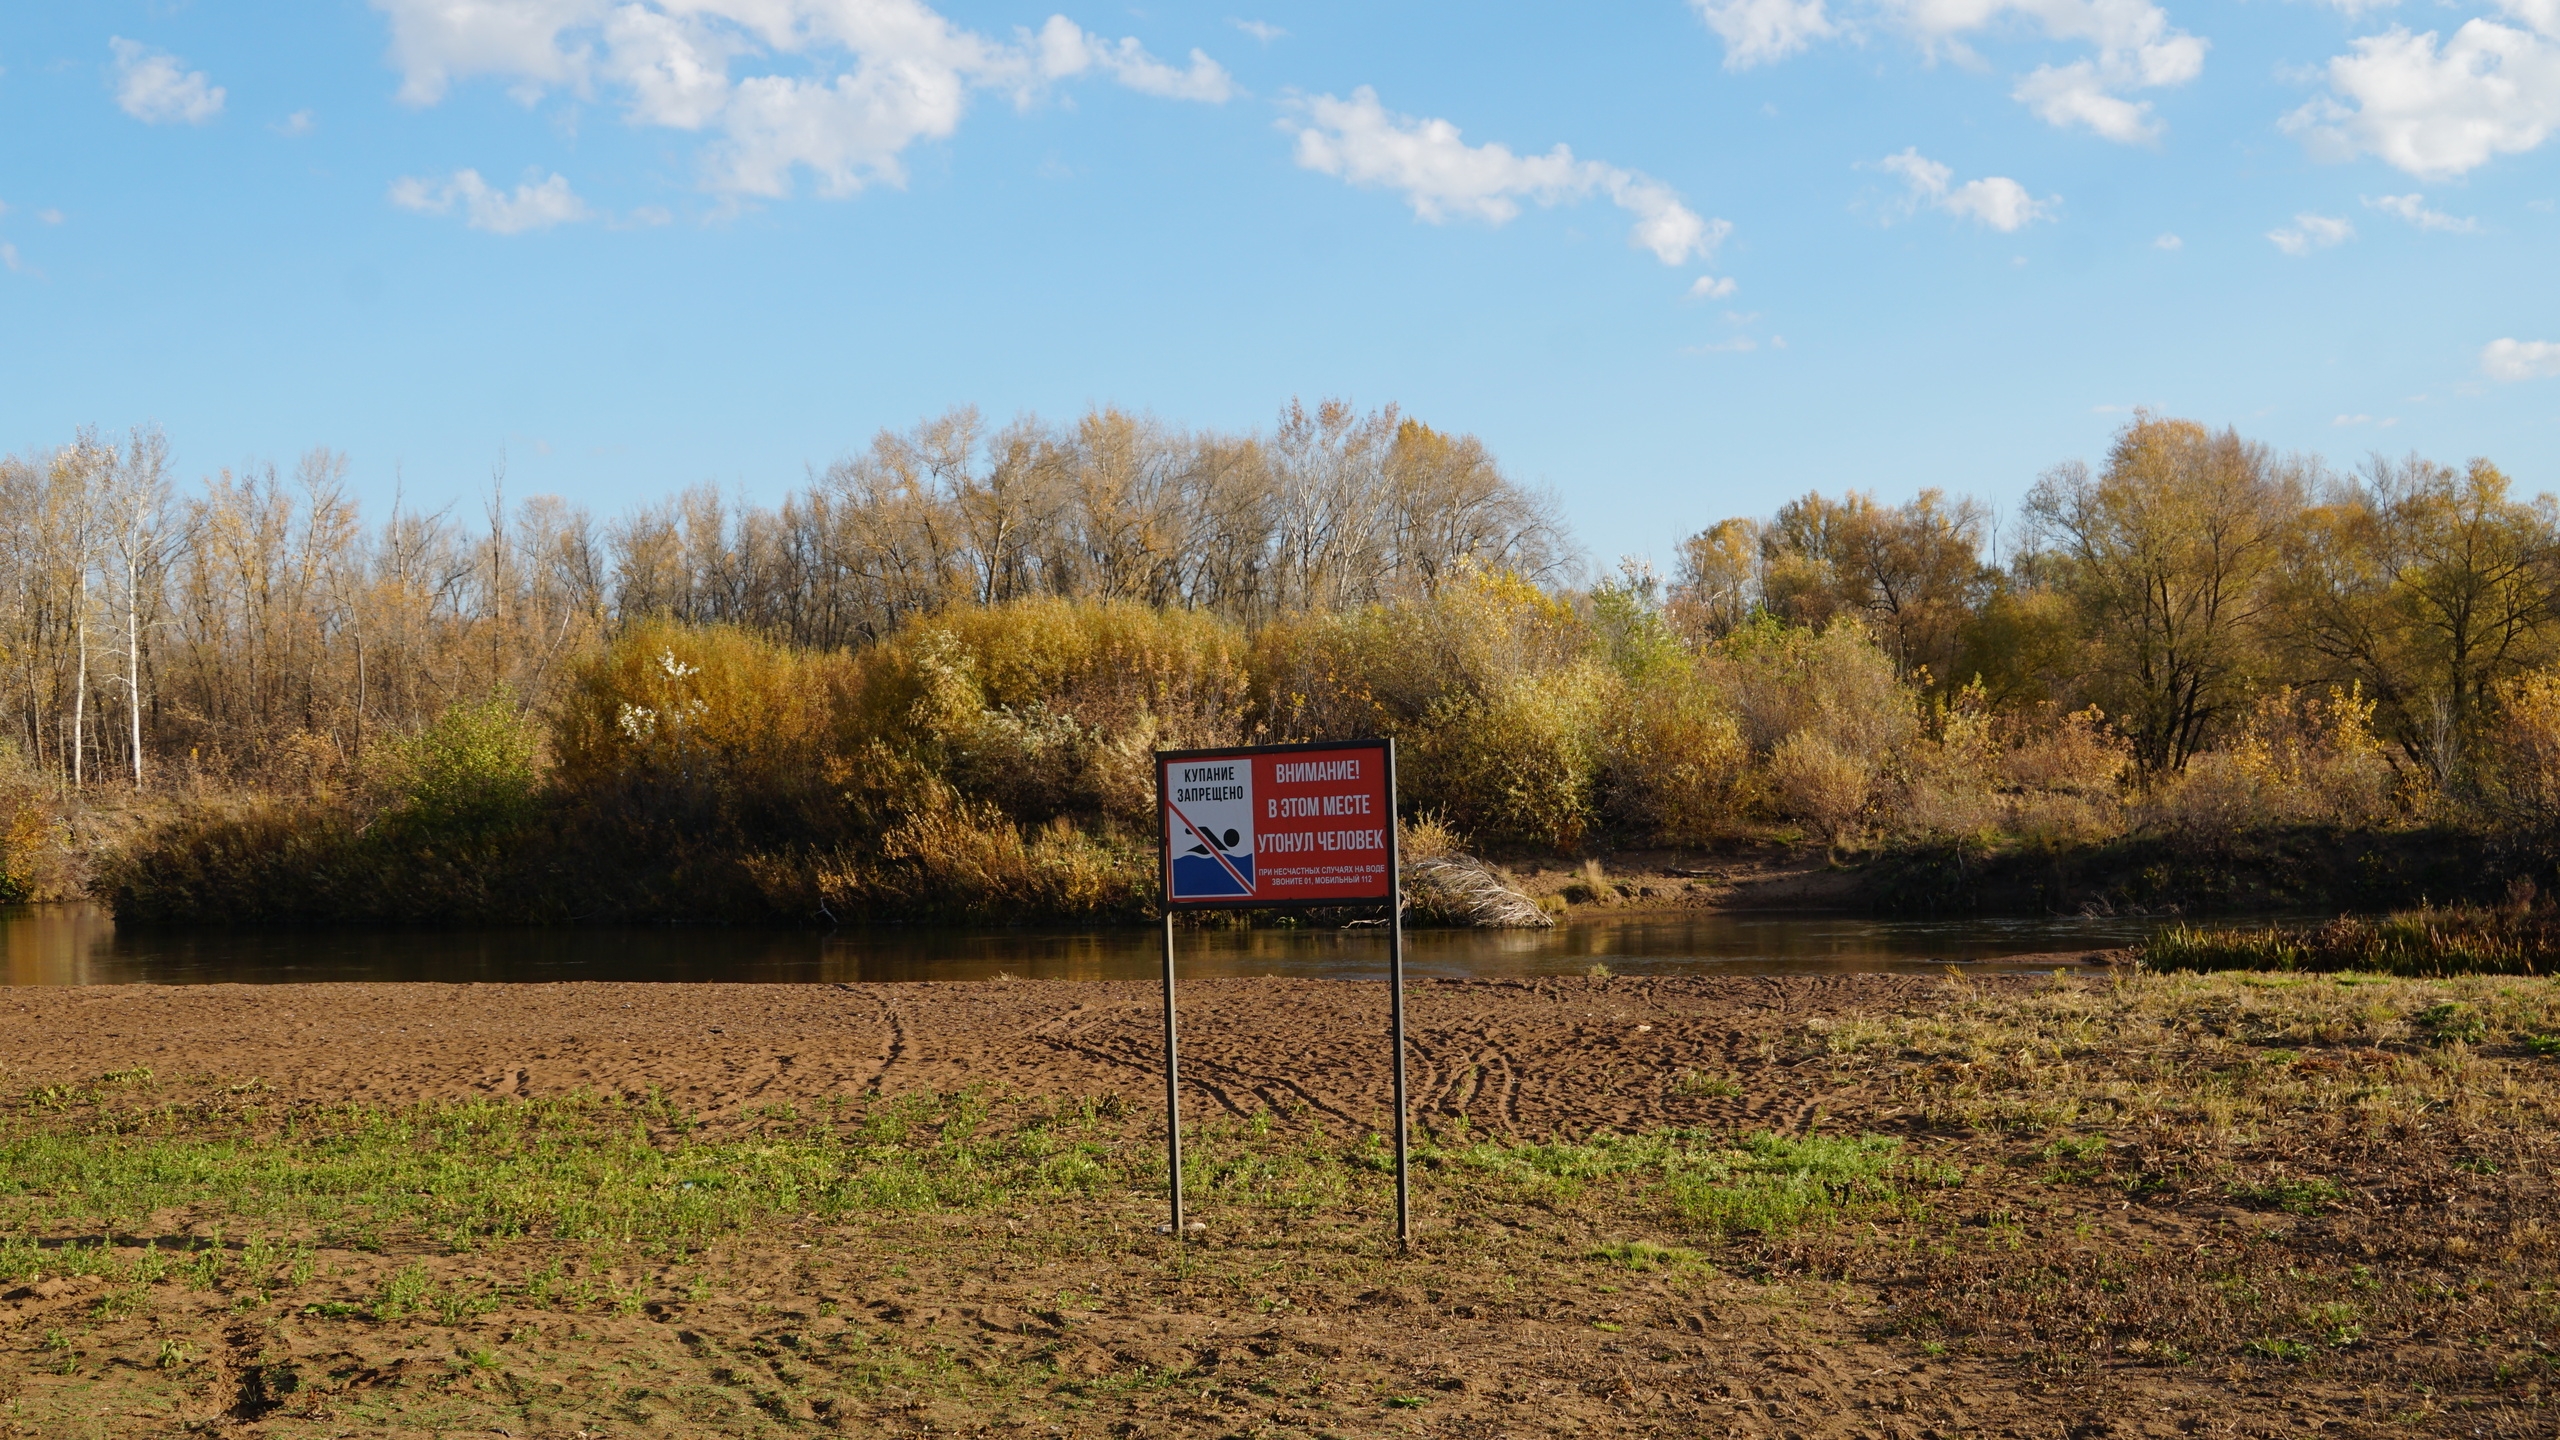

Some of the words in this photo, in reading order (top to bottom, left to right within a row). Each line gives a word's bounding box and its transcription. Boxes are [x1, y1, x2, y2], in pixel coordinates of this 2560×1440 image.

[1185, 767, 1234, 783] КУПАНИЕ
[1276, 760, 1360, 783] ВНИМАНИЕ!
[1177, 785, 1243, 802] ЗАПРЕЩЕНО
[1268, 799, 1277, 818] В
[1281, 797, 1319, 817] ЭТОМ
[1323, 795, 1370, 815] МЕСТЕ
[1258, 832, 1313, 853] УТОНУЛ
[1318, 829, 1384, 850] ЧЕЛОВЕК
[1259, 868, 1272, 876] ПРИ
[1274, 867, 1320, 875] НЕСЧАСТНЫХ
[1322, 866, 1353, 874] СЛУЧАЯХ
[1366, 865, 1385, 873] ВОДЕ
[1272, 877, 1303, 886] ЗВОНИТЕ
[1304, 877, 1313, 885] 01,
[1315, 875, 1359, 884] МОБИЛЬНЫЙ
